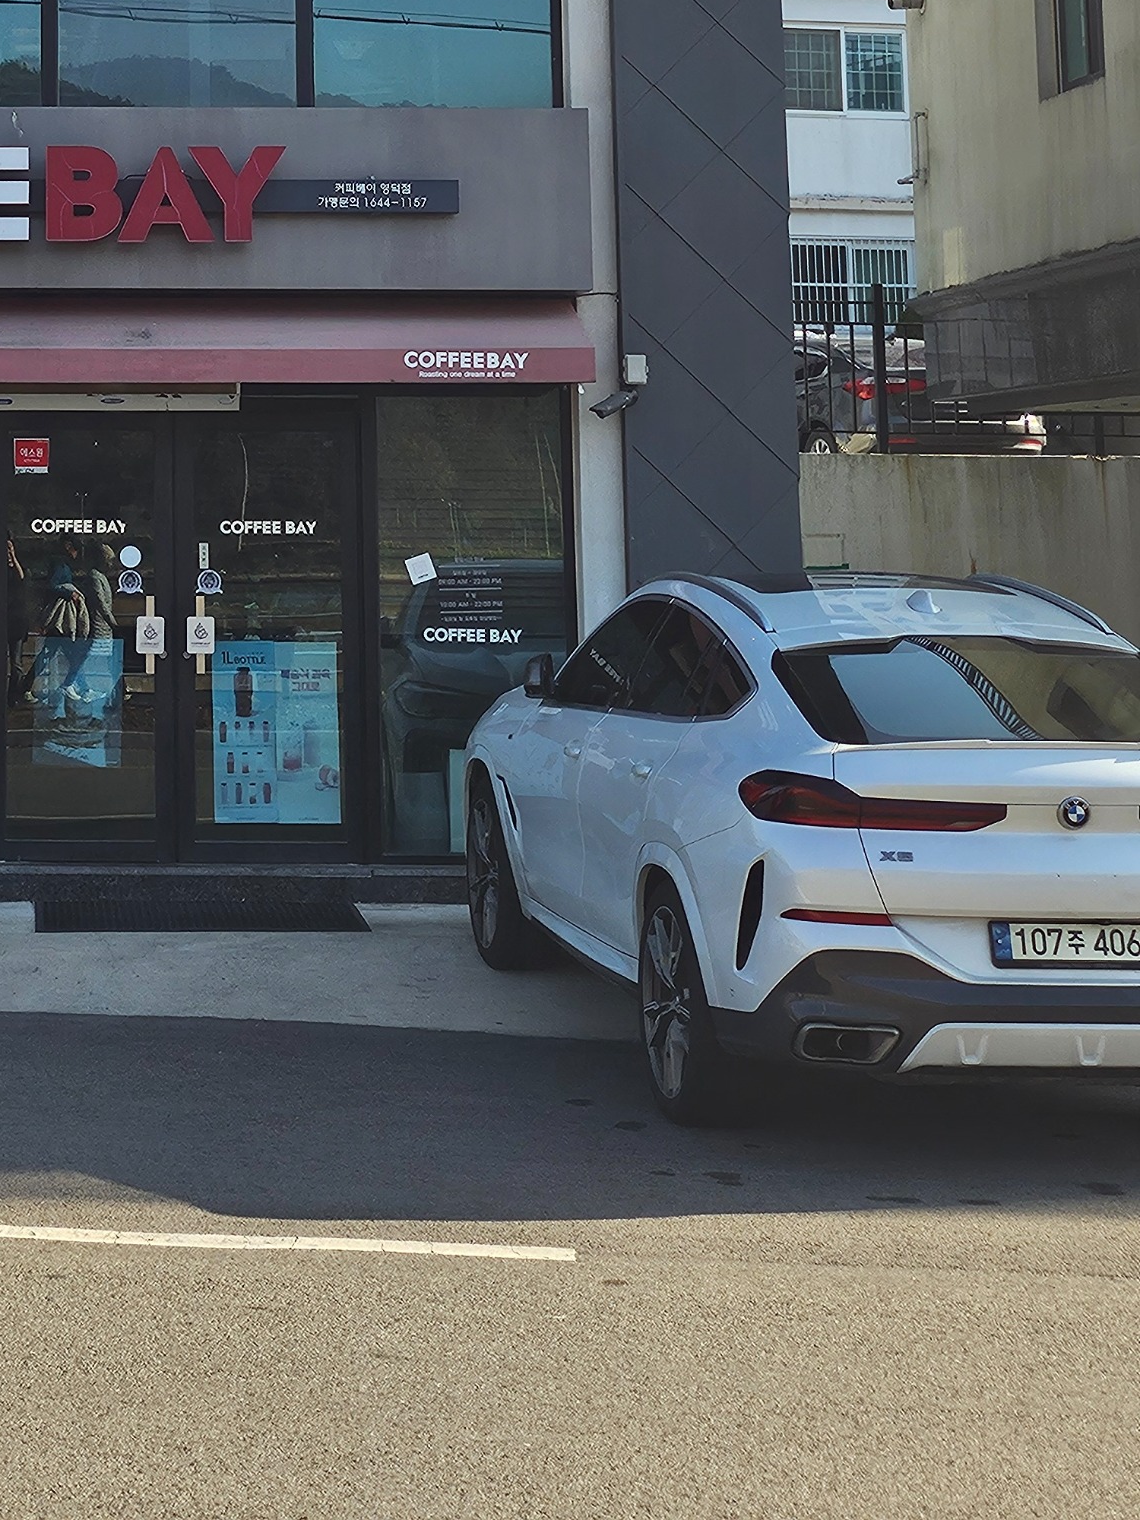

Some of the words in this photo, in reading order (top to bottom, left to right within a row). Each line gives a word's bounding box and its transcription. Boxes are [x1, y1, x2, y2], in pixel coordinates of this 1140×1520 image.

[334, 182, 376, 195] 커피베이
[379, 182, 411, 195] 영덕점
[318, 196, 360, 209] 가맹문의
[364, 196, 428, 209] 1644-1157
[403, 351, 529, 369] COFFEEBAY
[31, 519, 92, 533] COFFEE
[96, 519, 126, 534] BAY
[220, 520, 281, 534] COFFEE
[285, 520, 317, 534] BAY
[423, 627, 486, 643] COFFEE
[489, 629, 523, 643] BAY
[1015, 927, 1085, 956] 107주
